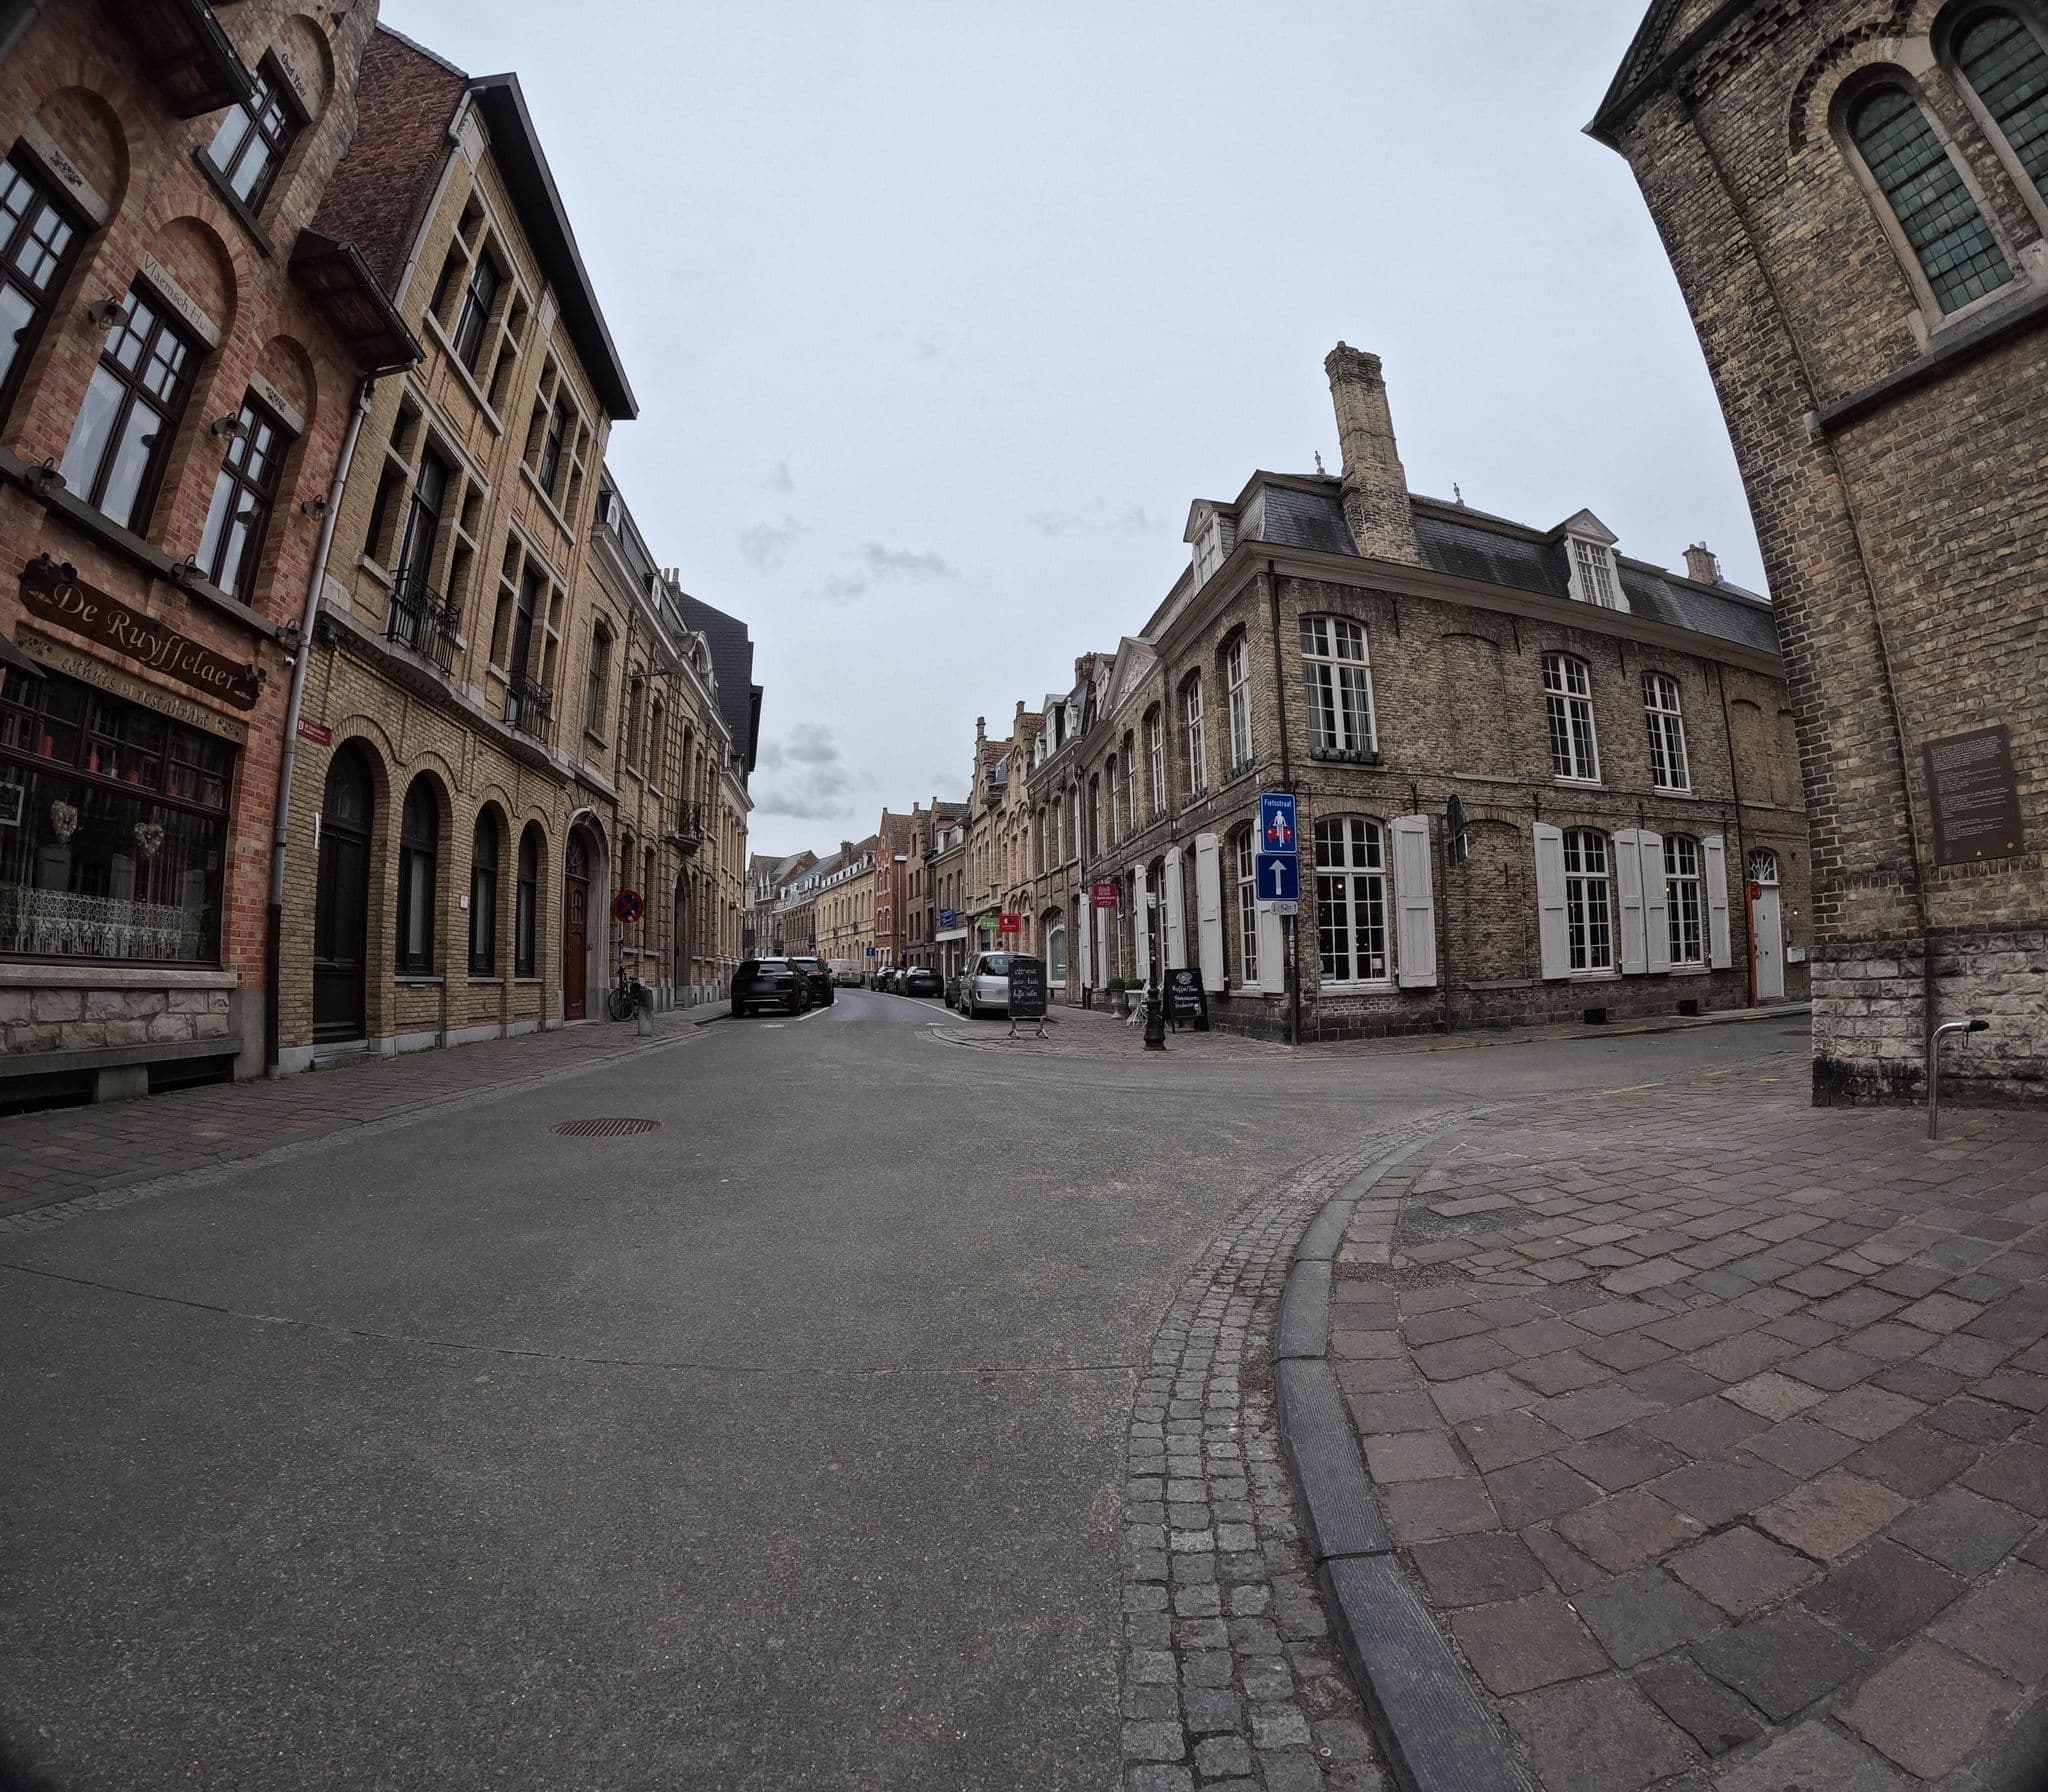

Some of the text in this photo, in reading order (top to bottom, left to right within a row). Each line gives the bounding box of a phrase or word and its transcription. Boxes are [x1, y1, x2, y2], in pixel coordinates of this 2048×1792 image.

[144, 253, 188, 313] Vlaemsch
[54, 583, 239, 690] De Ruyffelaer
[1264, 798, 1292, 808] Fietsstraat
